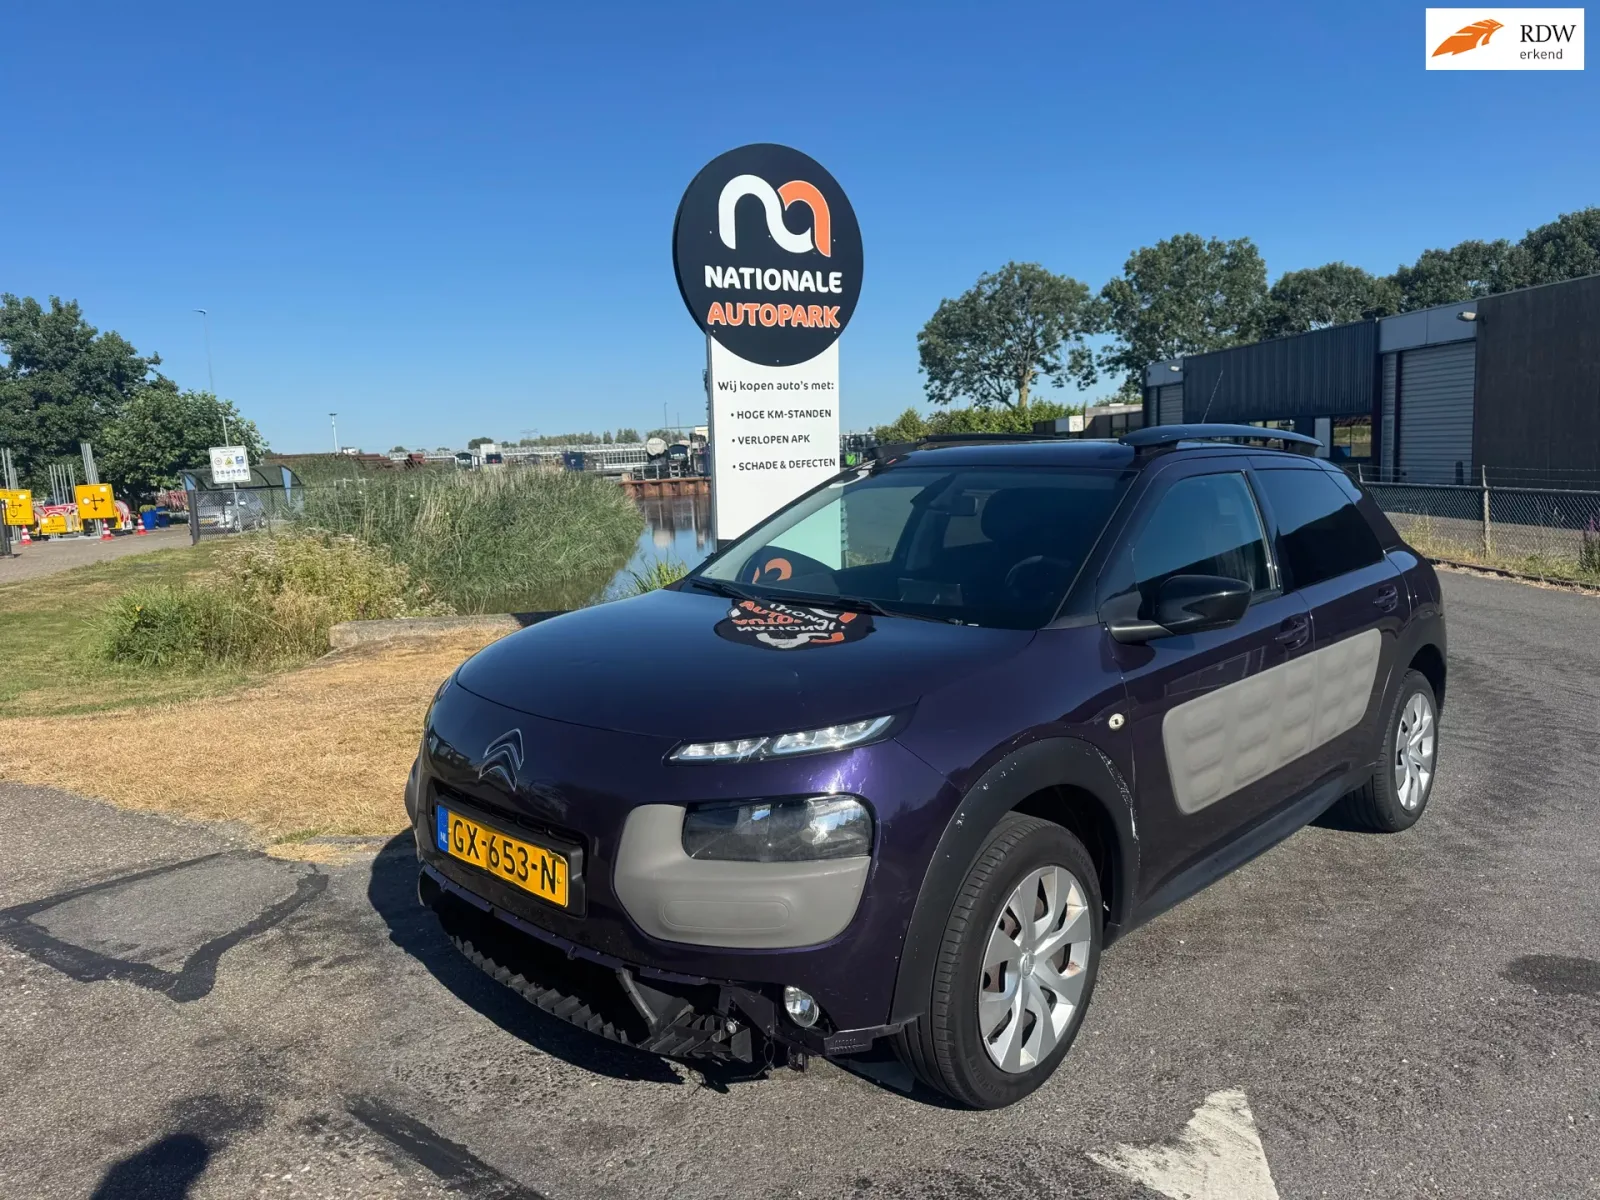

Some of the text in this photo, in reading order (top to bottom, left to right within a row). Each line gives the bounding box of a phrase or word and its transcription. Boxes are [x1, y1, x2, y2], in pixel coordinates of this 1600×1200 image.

[704, 265, 843, 293] NATIONALE
[706, 301, 841, 328] AUTOPARK
[718, 381, 834, 393] Wij kopen auto's met:
[737, 409, 832, 419] HOGE KM-STANDEN
[738, 434, 811, 445] VERLOPEN APK
[738, 458, 836, 471] SCHADE & DEFECTEN
[453, 819, 557, 895] GX-653-N
